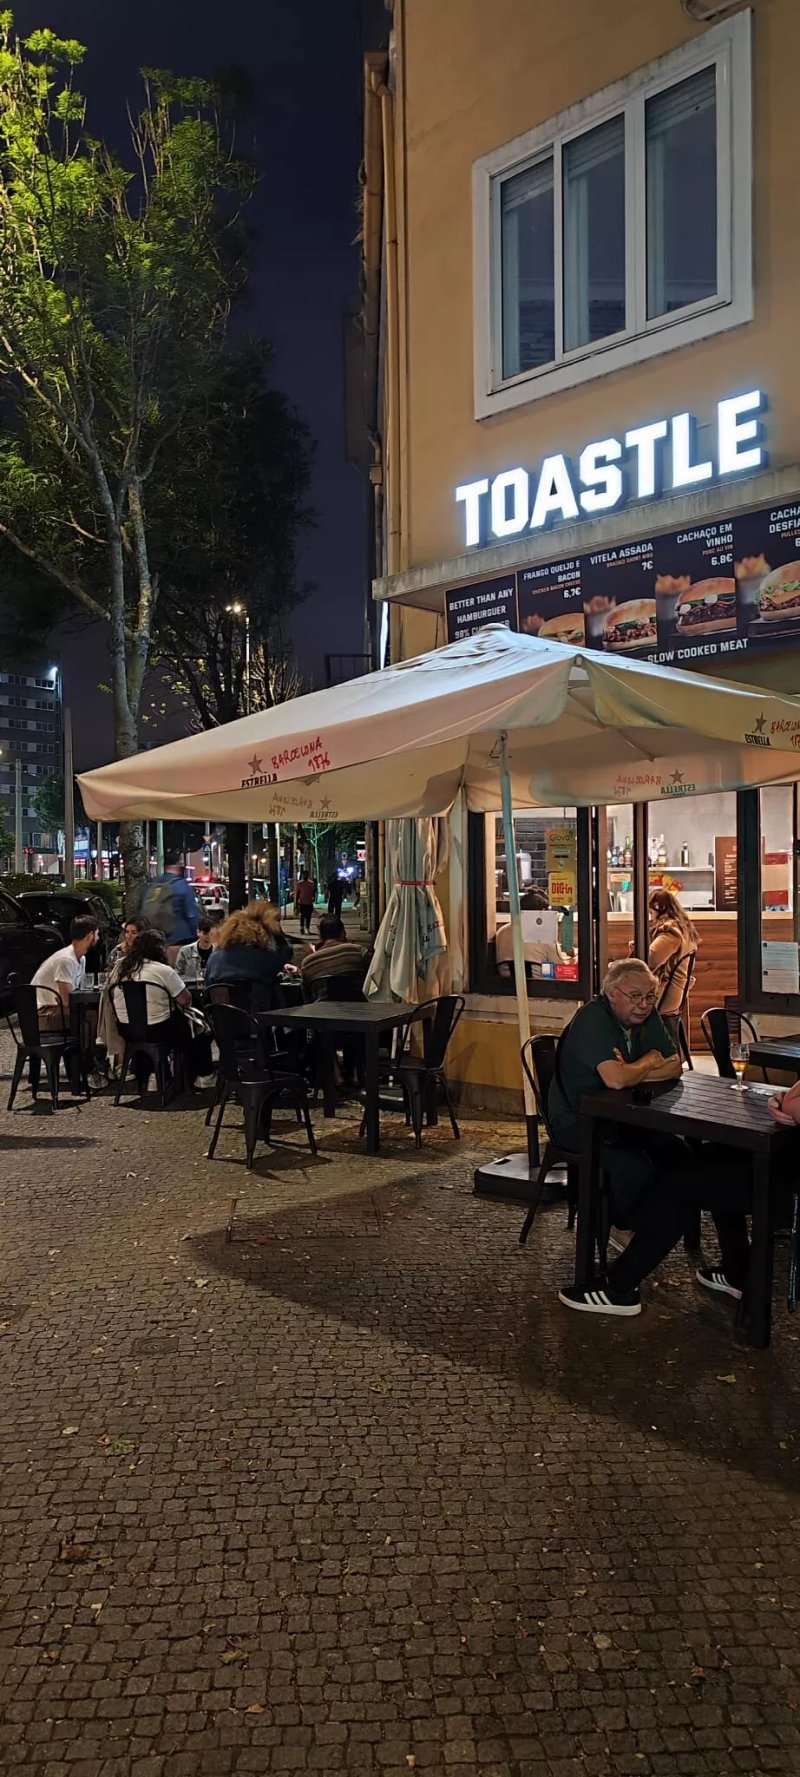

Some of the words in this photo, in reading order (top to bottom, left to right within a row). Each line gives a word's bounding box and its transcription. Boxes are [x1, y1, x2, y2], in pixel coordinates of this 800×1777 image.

[456, 390, 763, 546] TOASTLE
[677, 527, 717, 543] CACHAÇO
[720, 523, 733, 533] EM
[706, 534, 733, 548] VINHO
[590, 551, 617, 565] VITELA
[620, 543, 653, 559] ASSADA
[551, 562, 574, 576] QUEIJO
[576, 560, 581, 568] E
[642, 561, 653, 571] 7€
[558, 571, 581, 583] BACON
[449, 598, 474, 611] BETTER
[476, 594, 496, 605] THAN
[498, 588, 514, 600] ANY
[457, 605, 507, 624] HAMBURGUER
[647, 651, 675, 663] SLOW
[678, 644, 717, 660] COOKED
[720, 638, 748, 652] MEAT
[271, 736, 322, 769] BARCELONA
[308, 752, 331, 772] 1876
